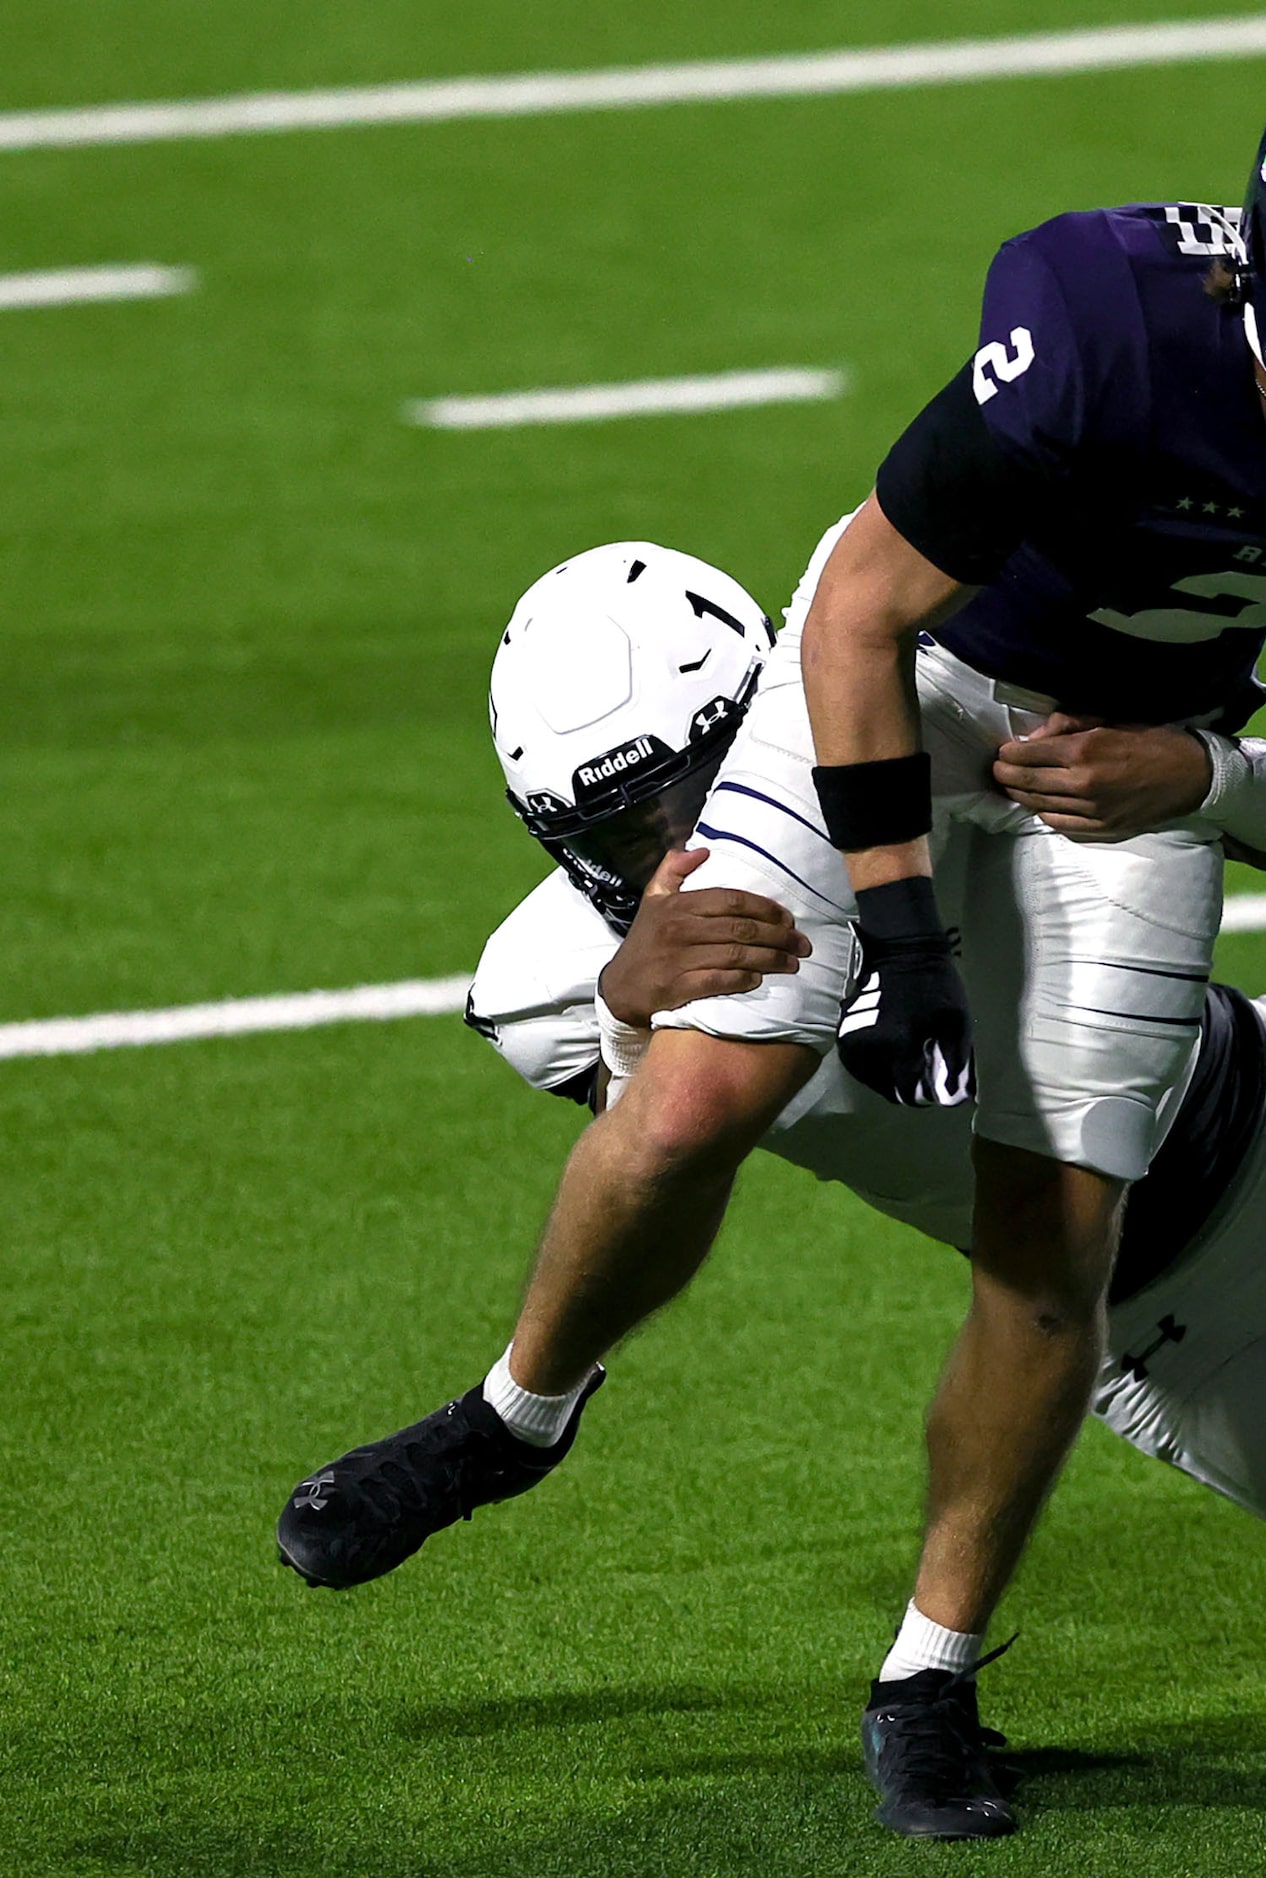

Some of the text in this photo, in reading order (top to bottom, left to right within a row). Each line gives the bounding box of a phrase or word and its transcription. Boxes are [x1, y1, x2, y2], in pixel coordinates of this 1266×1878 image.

[973, 326, 1035, 405] 2
[685, 589, 745, 638] 1
[577, 738, 654, 787] Riddell
